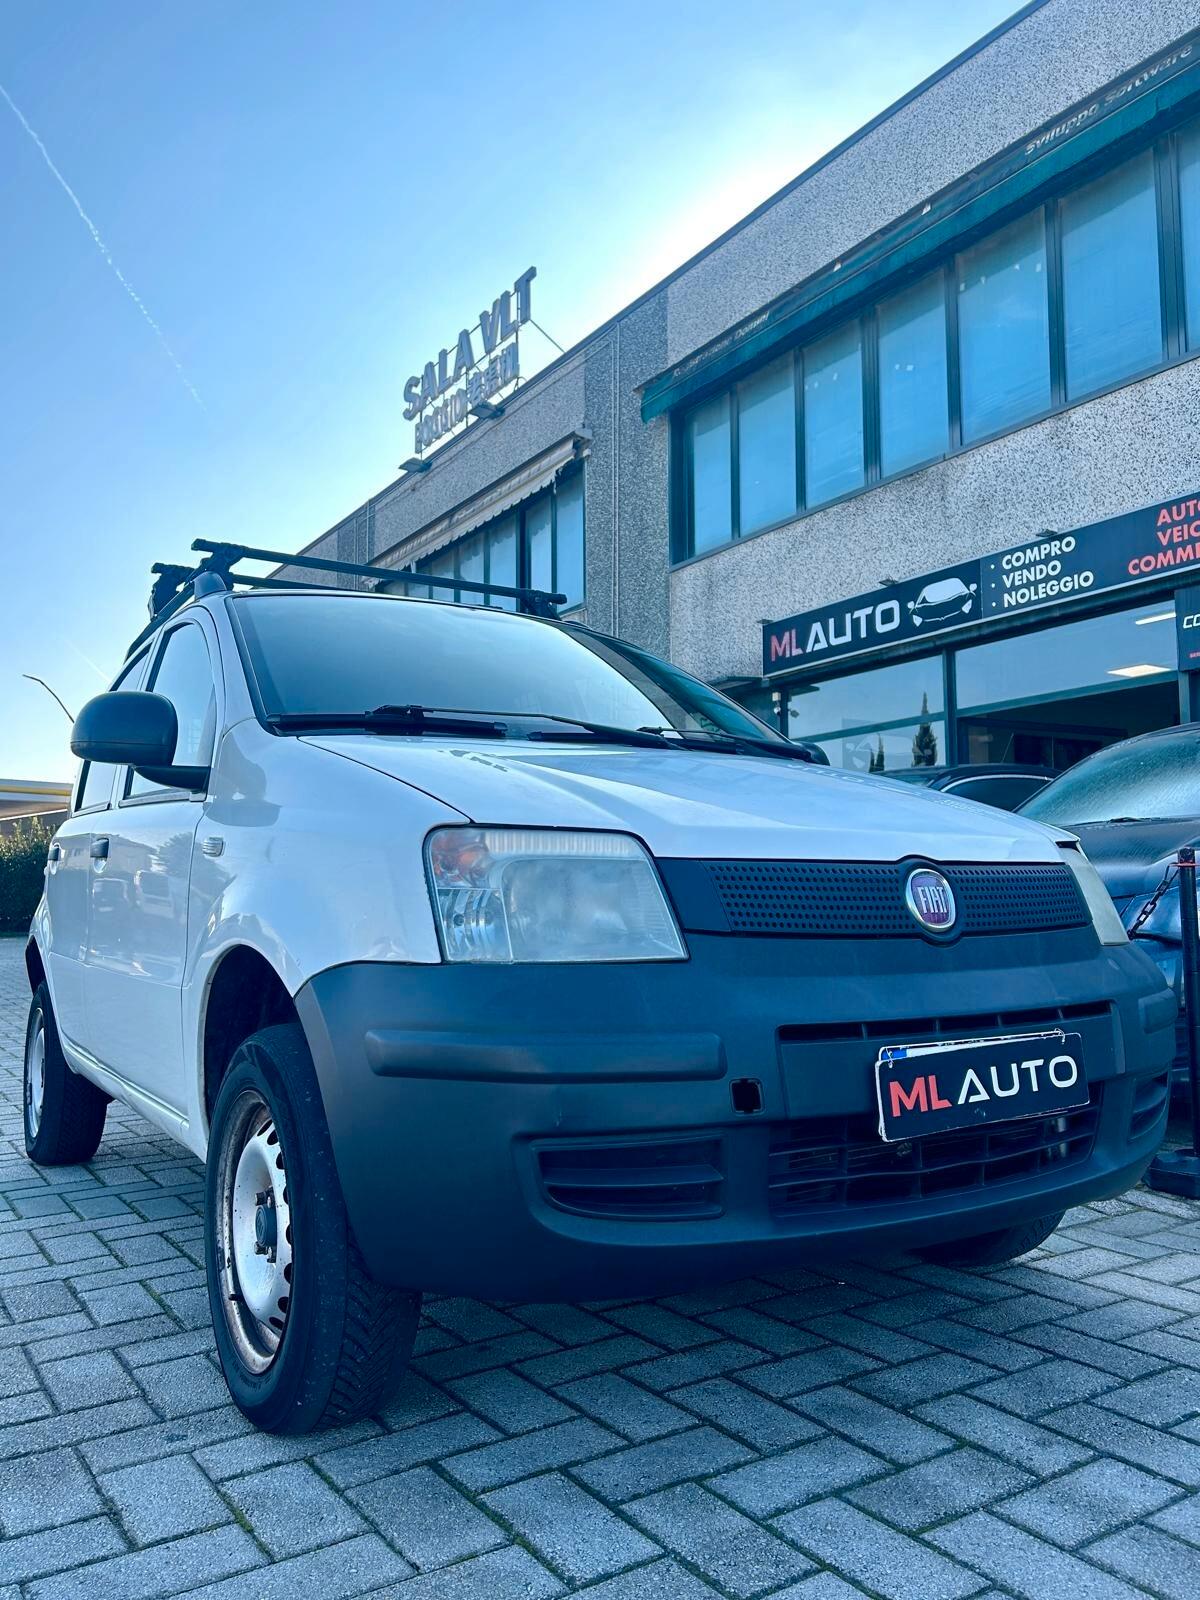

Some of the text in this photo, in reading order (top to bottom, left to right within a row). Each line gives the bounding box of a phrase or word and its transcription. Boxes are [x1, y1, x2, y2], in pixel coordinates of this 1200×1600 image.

[1025, 103, 1099, 155] Sviluppo
[402, 328, 475, 421] SALA
[479, 266, 537, 354] VLT
[1156, 499, 1200, 526] AUT
[1002, 536, 1076, 570] COMPRO
[1002, 560, 1062, 588] VENDO
[1003, 571, 1094, 608] NOLEGGIO
[770, 599, 900, 662] ML AUTO
[917, 886, 947, 913] FIAT
[889, 1055, 1078, 1118] ML AUTO
